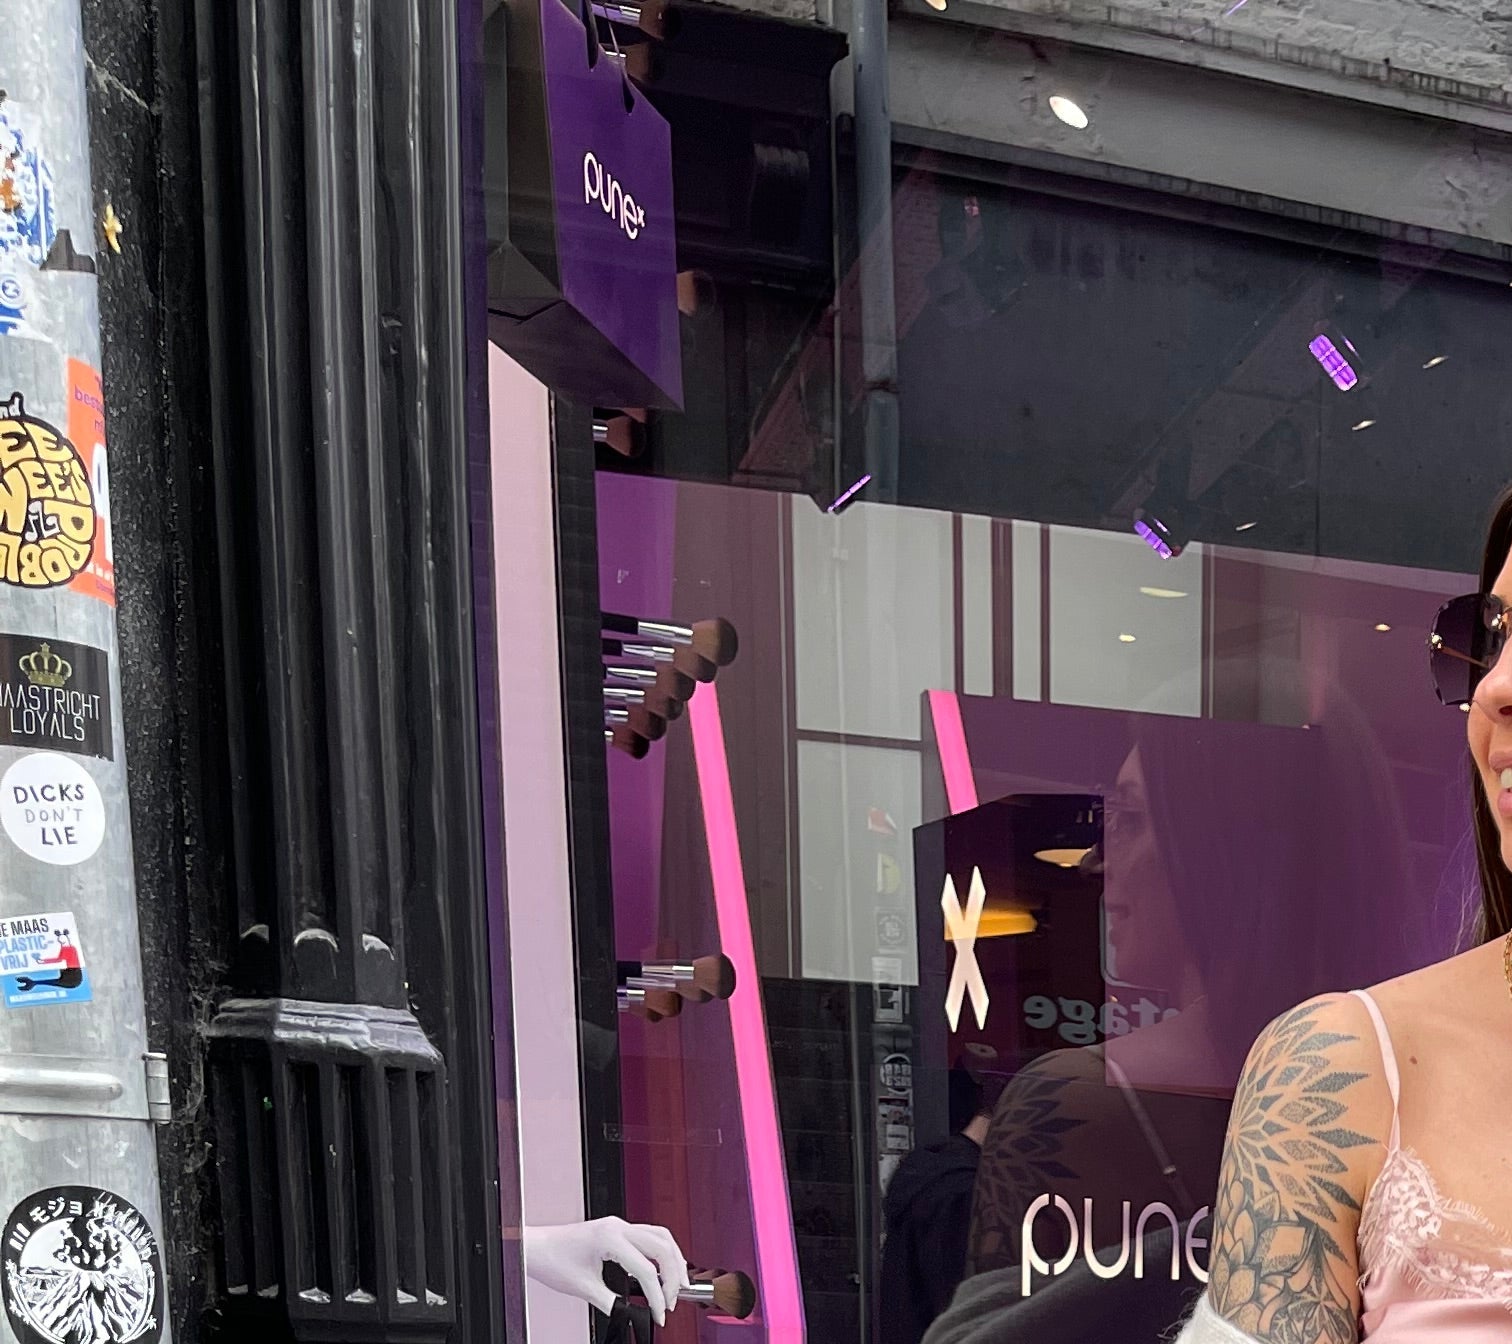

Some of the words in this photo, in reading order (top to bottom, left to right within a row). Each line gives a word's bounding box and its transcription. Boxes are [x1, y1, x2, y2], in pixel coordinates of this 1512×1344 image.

[0, 683, 101, 721] AASTRICHT
[10, 707, 85, 741] LOYALS
[13, 783, 85, 804] DICKS
[25, 806, 83, 823] DON'T
[41, 826, 78, 846] LIE
[10, 918, 49, 936] MAAS
[1, 954, 29, 970] VRIJ
